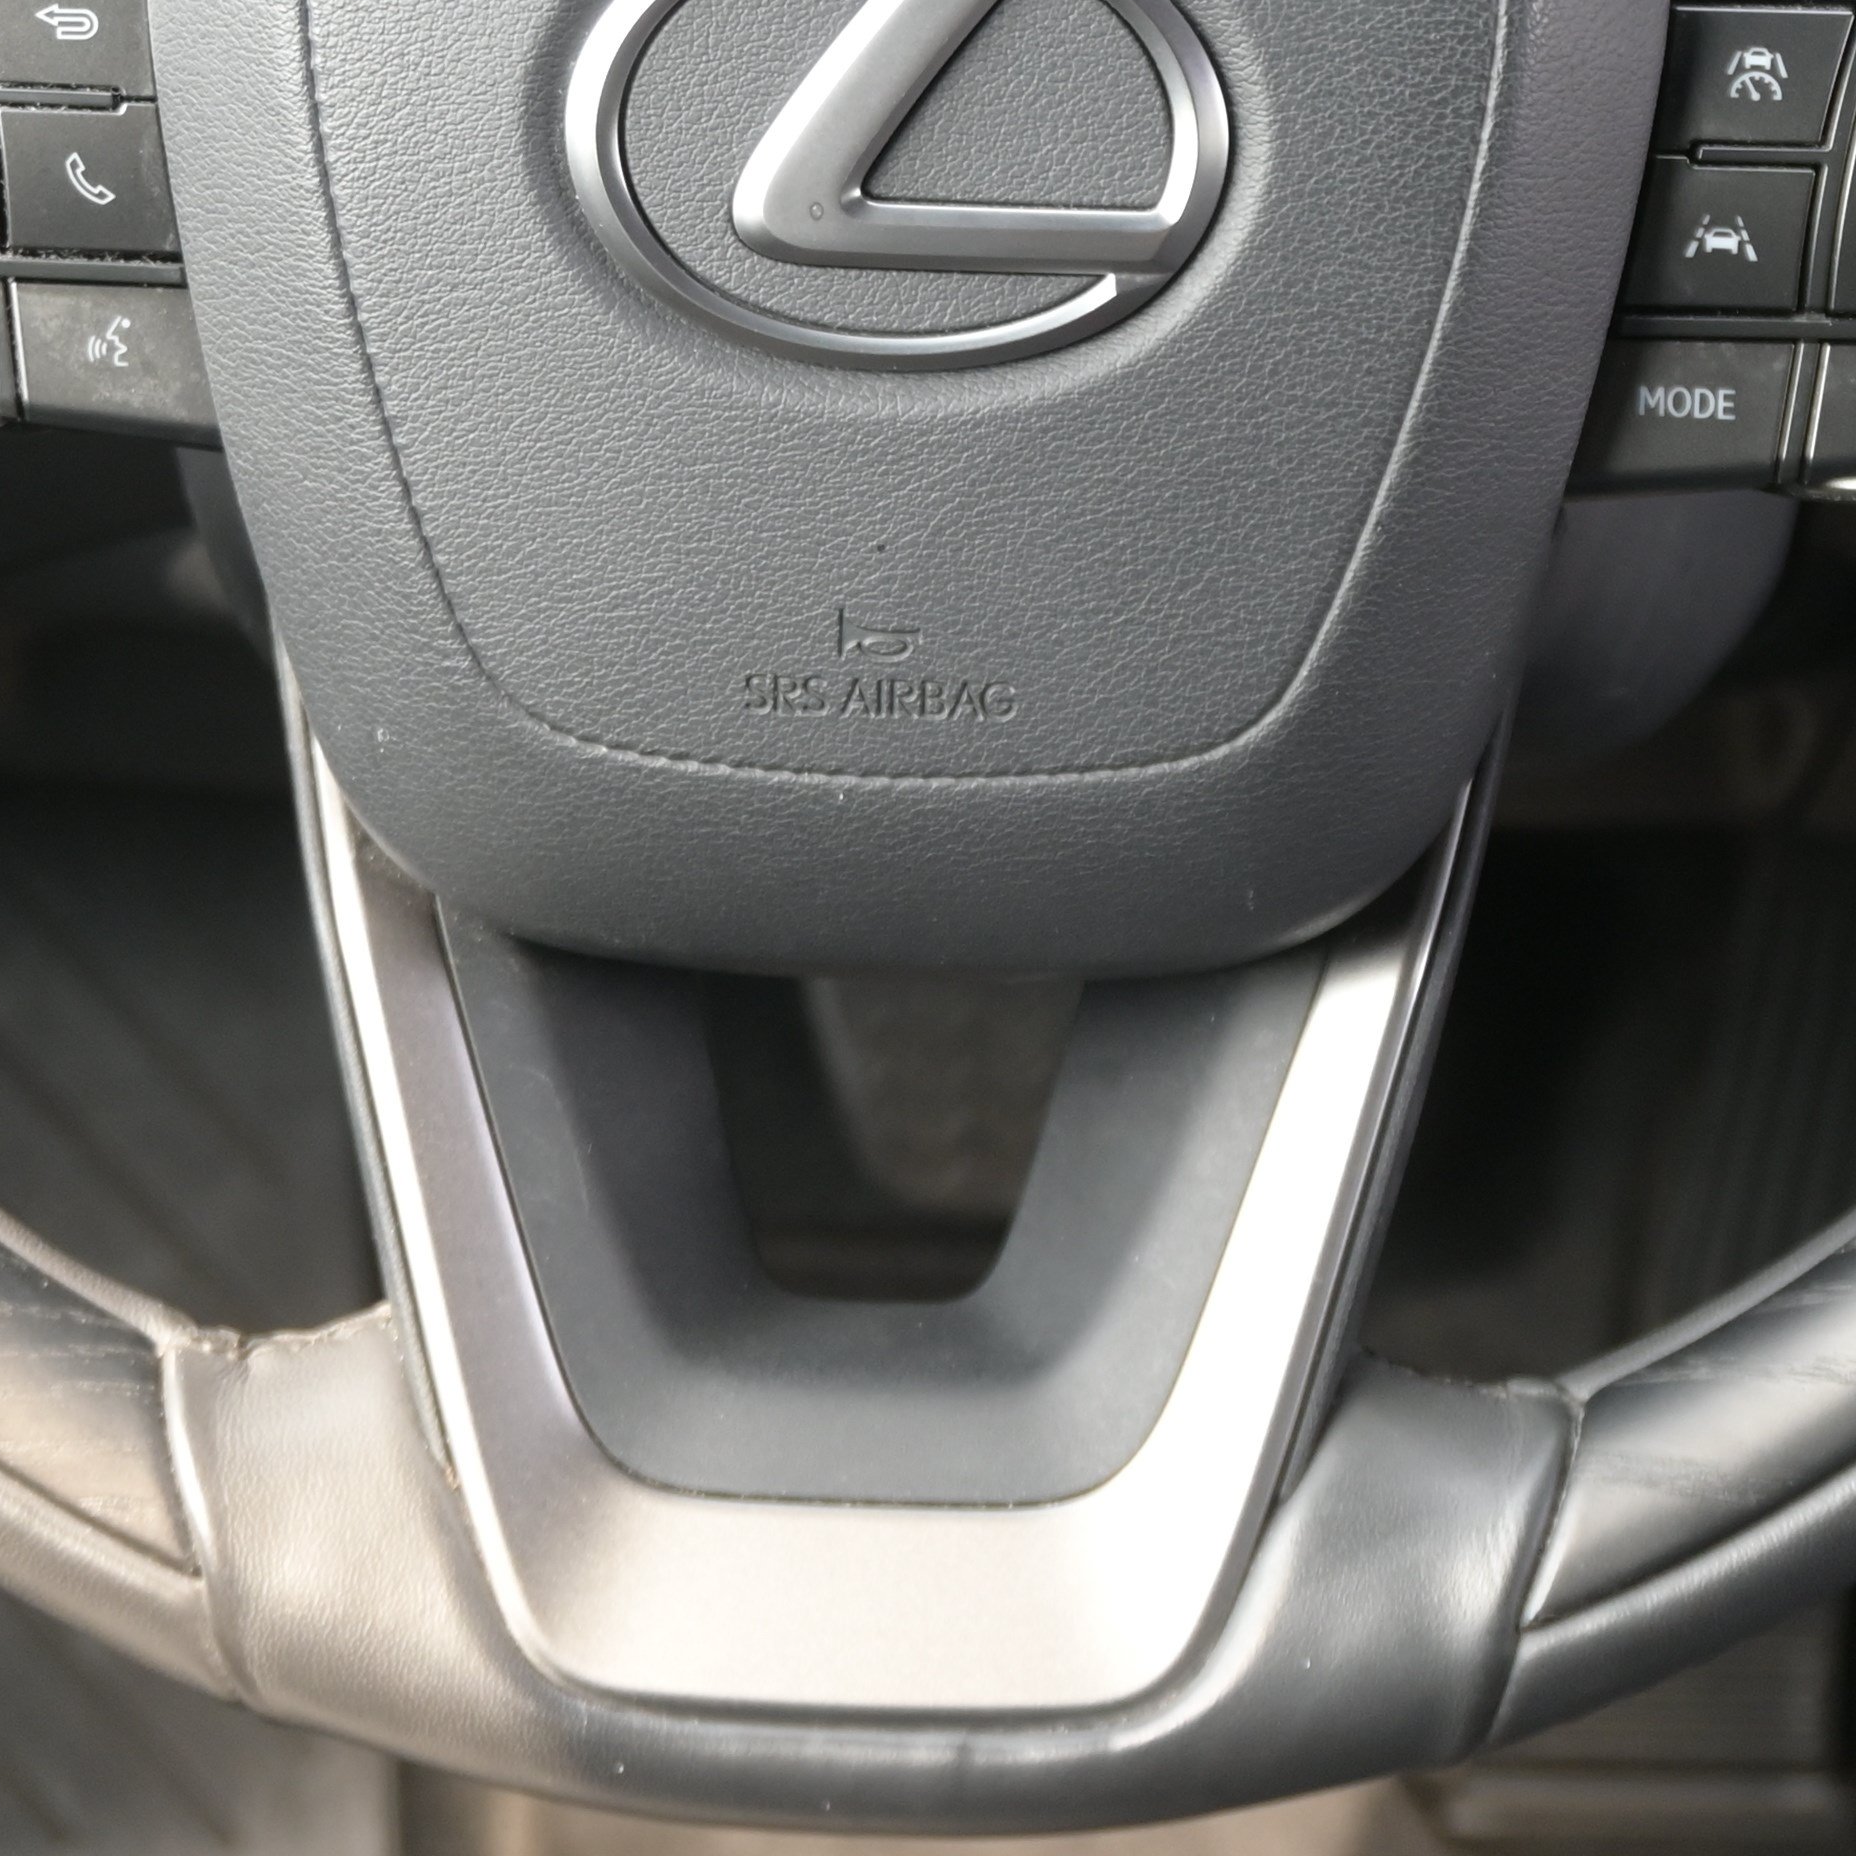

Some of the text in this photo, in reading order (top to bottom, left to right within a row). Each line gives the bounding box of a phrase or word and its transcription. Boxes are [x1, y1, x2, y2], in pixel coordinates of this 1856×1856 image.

[1638, 388, 1736, 421] MODE
[745, 673, 1019, 722] SRS AIRBAG
